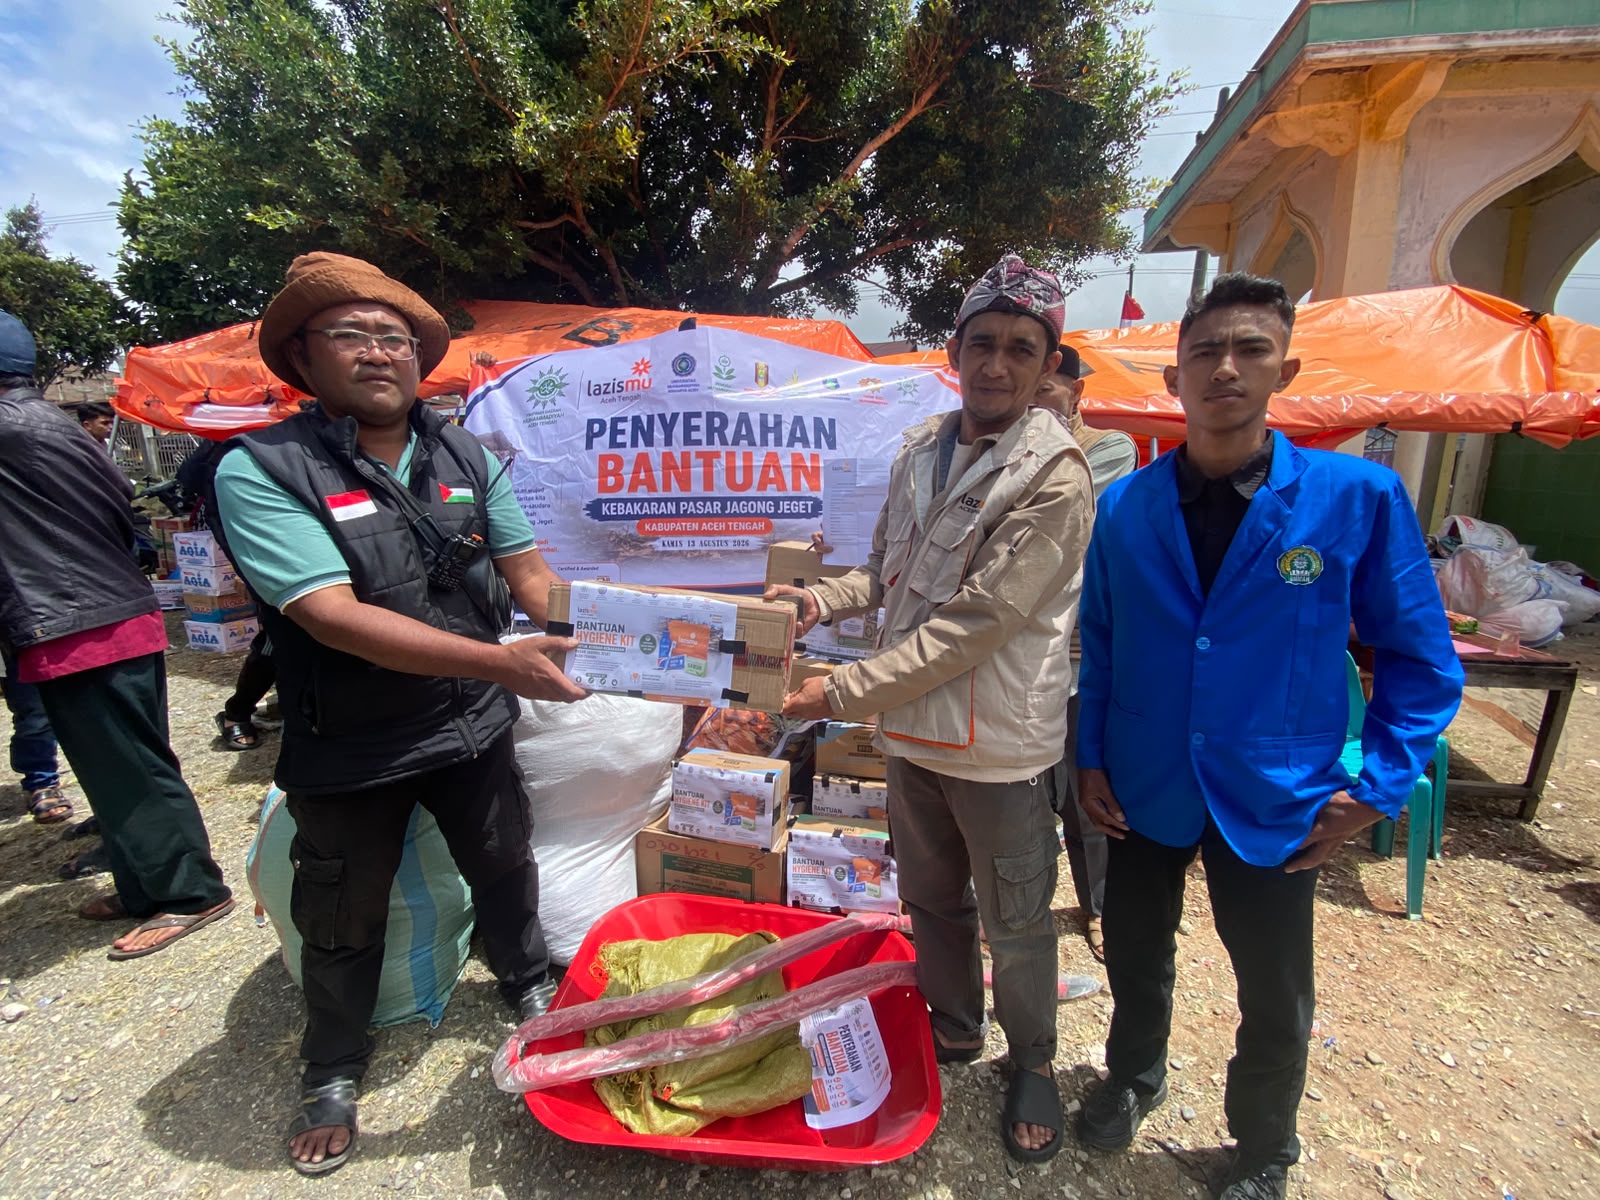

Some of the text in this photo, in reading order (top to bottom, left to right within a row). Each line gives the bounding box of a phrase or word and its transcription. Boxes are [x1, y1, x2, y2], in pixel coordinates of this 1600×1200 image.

[587, 377, 653, 397] lazismu
[600, 395, 641, 405] Aceh Tengah
[585, 411, 837, 450] PENYERAHAN
[597, 450, 822, 494] BANTUAN
[602, 500, 813, 515] KEBAKARAN PASAR JAGONG JEGET
[644, 521, 765, 532] KABUPATEN ACEH TENGAH
[662, 540, 683, 548] KAMIS
[576, 621, 625, 633] BANTUAN
[576, 630, 618, 646] HYGIENE
[621, 634, 636, 647] KIT
[674, 789, 704, 800] BANTUAN
[813, 804, 843, 814] BANTUAN
[792, 857, 825, 867] BANTUAN
[792, 865, 831, 876] HYGIENE KIT
[825, 1029, 850, 1074] BANTUAN
[838, 1024, 864, 1073] PENYERAHAN
